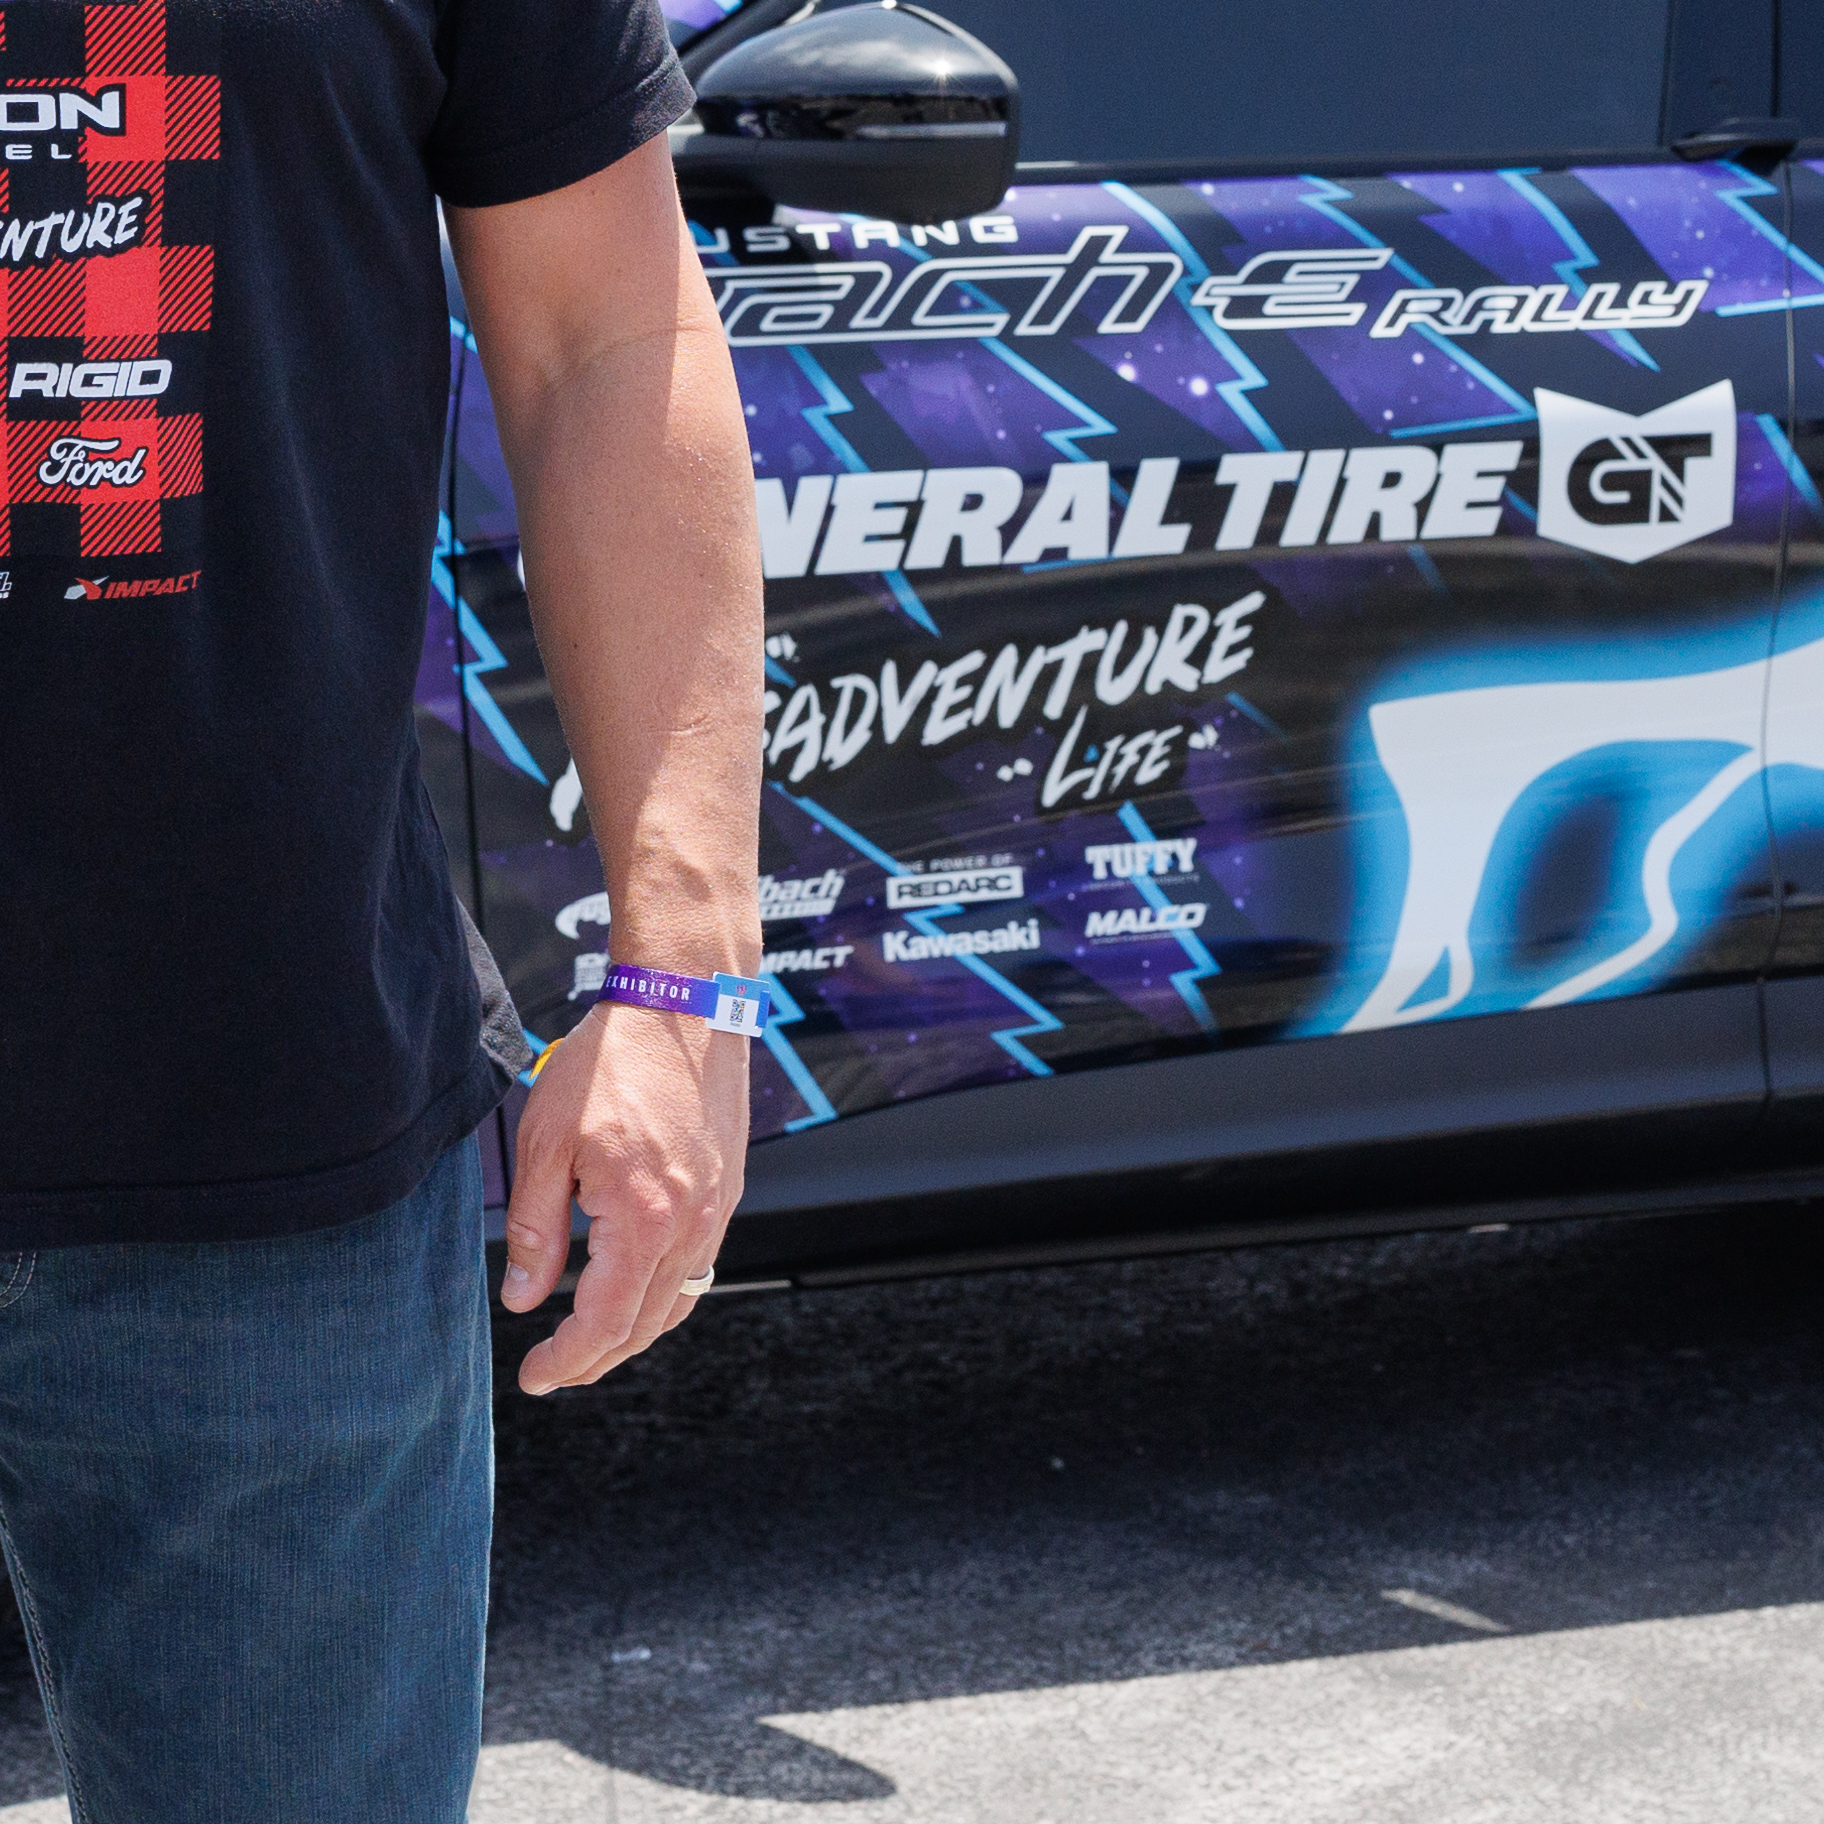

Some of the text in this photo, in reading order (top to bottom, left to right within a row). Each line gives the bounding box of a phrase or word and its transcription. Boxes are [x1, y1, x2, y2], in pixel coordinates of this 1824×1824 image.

[697, 215, 1018, 254] USTANG
[706, 225, 1183, 347] ach
[1369, 280, 1710, 338] RALLY
[9, 360, 173, 397] RIGID
[39, 438, 144, 486] Ford
[1566, 433, 1714, 527] GT
[755, 441, 1523, 578] NERAL TIRE
[104, 570, 202, 599] IMPACT
[1085, 838, 1197, 880] TUFFY
[897, 874, 1013, 899] REDARC
[1084, 903, 1207, 938] MALCO
[761, 945, 855, 974] MPACT
[883, 918, 1041, 963] Kawasaki
[605, 976, 690, 1000] EXHIBITOR
